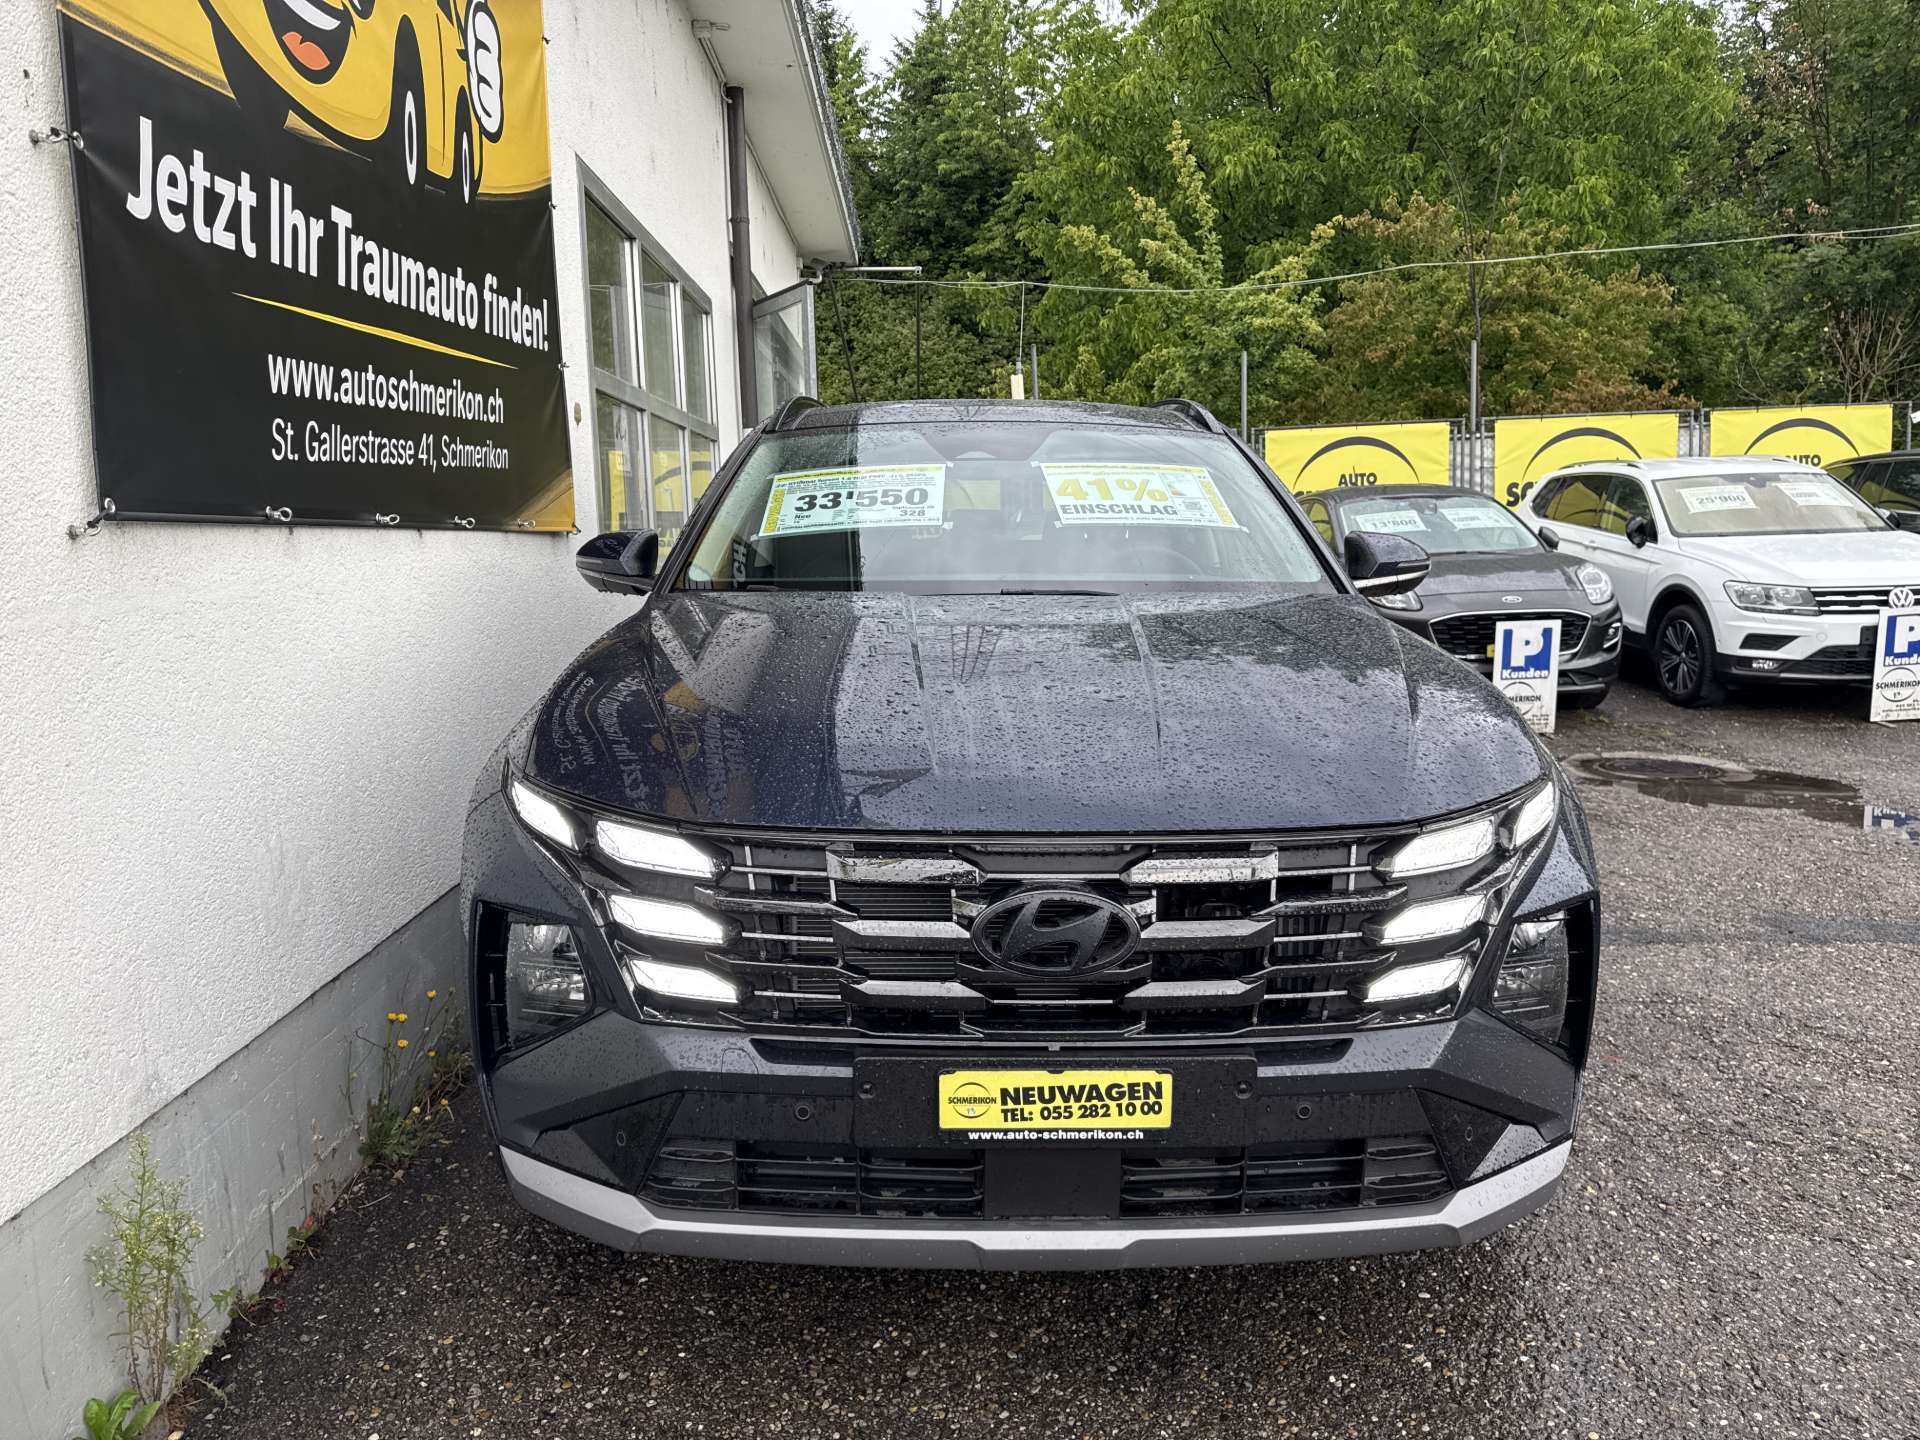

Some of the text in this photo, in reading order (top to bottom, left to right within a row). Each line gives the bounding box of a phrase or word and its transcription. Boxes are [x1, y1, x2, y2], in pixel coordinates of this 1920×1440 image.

[126, 115, 549, 352] Jetzt Ihr Traumauto finden!
[268, 353, 504, 424] www.autoschmerikon.ch
[271, 418, 509, 473] St. Gallerstrasse 41, Schmerikon
[1055, 478, 1169, 502] 41%
[1338, 472, 1378, 487] AUTO
[794, 487, 929, 512] 33'550
[1060, 503, 1178, 516] EINSCHLAG
[1502, 667, 1549, 679] Kunden
[948, 1081, 1163, 1106] SCHMERIKON NEUWAGEN
[1001, 1101, 1163, 1122] TEL: 055 282 10 00
[968, 1129, 1144, 1140] www.auto-schmerikon.ch
